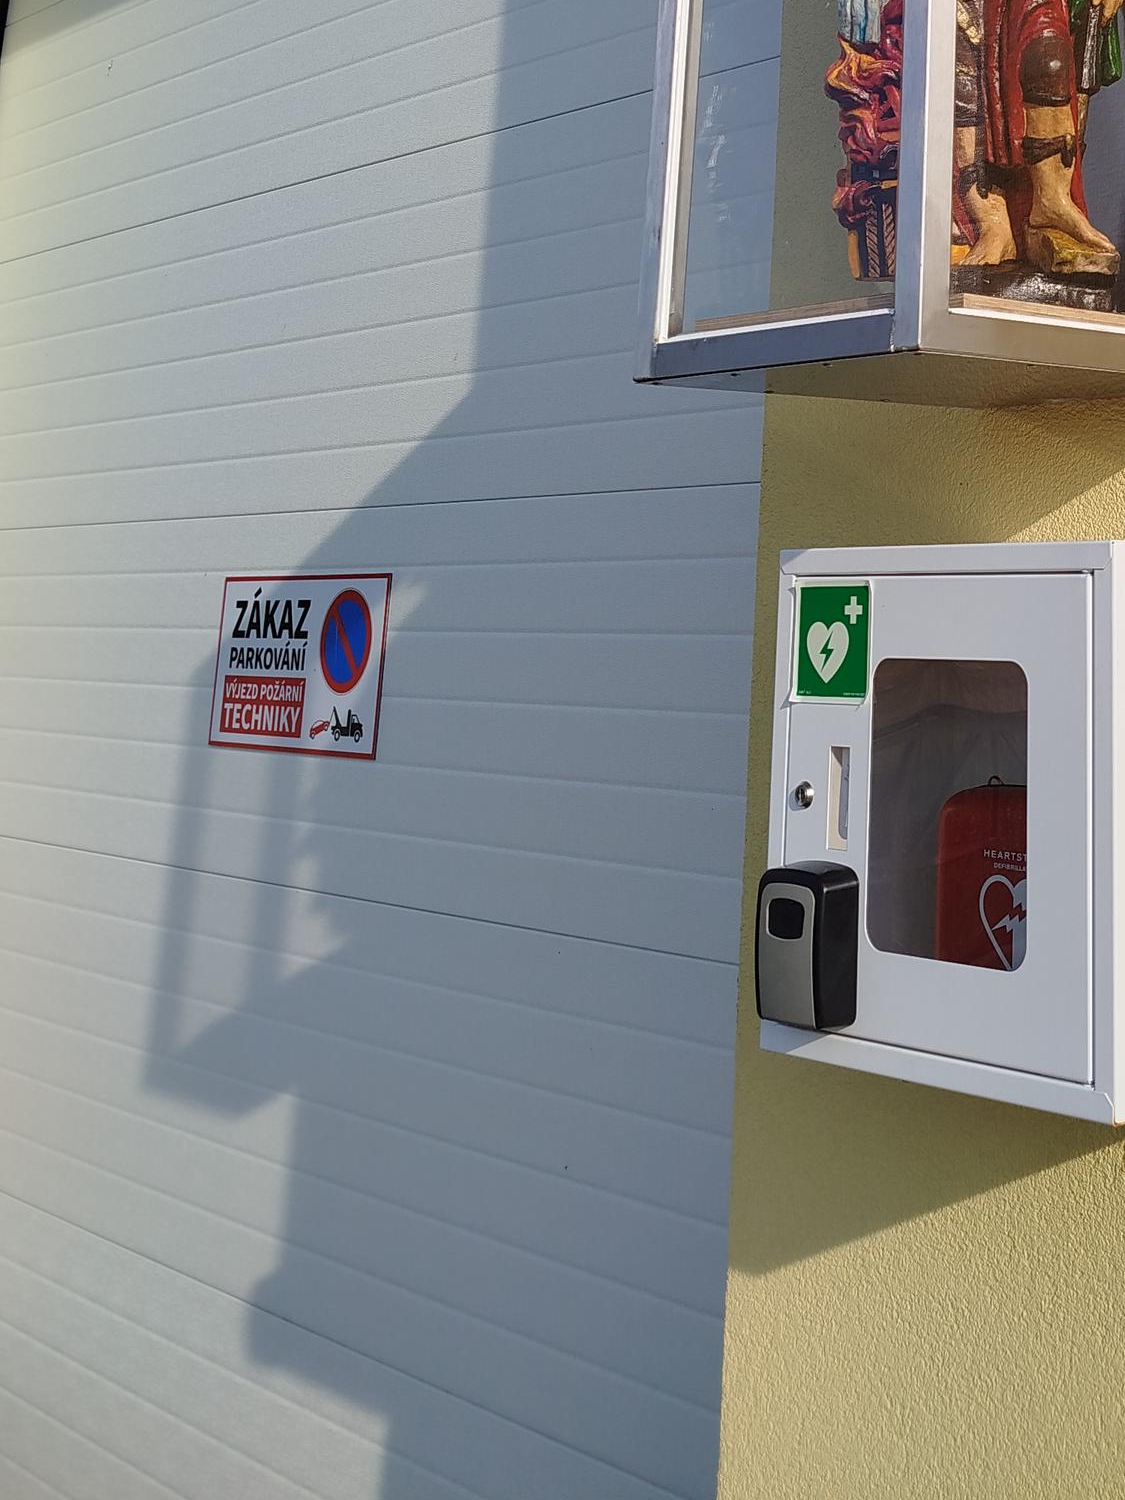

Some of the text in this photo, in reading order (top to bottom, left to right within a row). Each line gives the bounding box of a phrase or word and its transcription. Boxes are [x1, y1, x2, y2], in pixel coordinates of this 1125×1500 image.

[232, 587, 311, 640] ZÁKAZ
[229, 641, 308, 671] PARKOVÁNÍ
[225, 679, 304, 702] VÝJEZD POŽÁRNÍ
[223, 703, 301, 734] TECHNIKY
